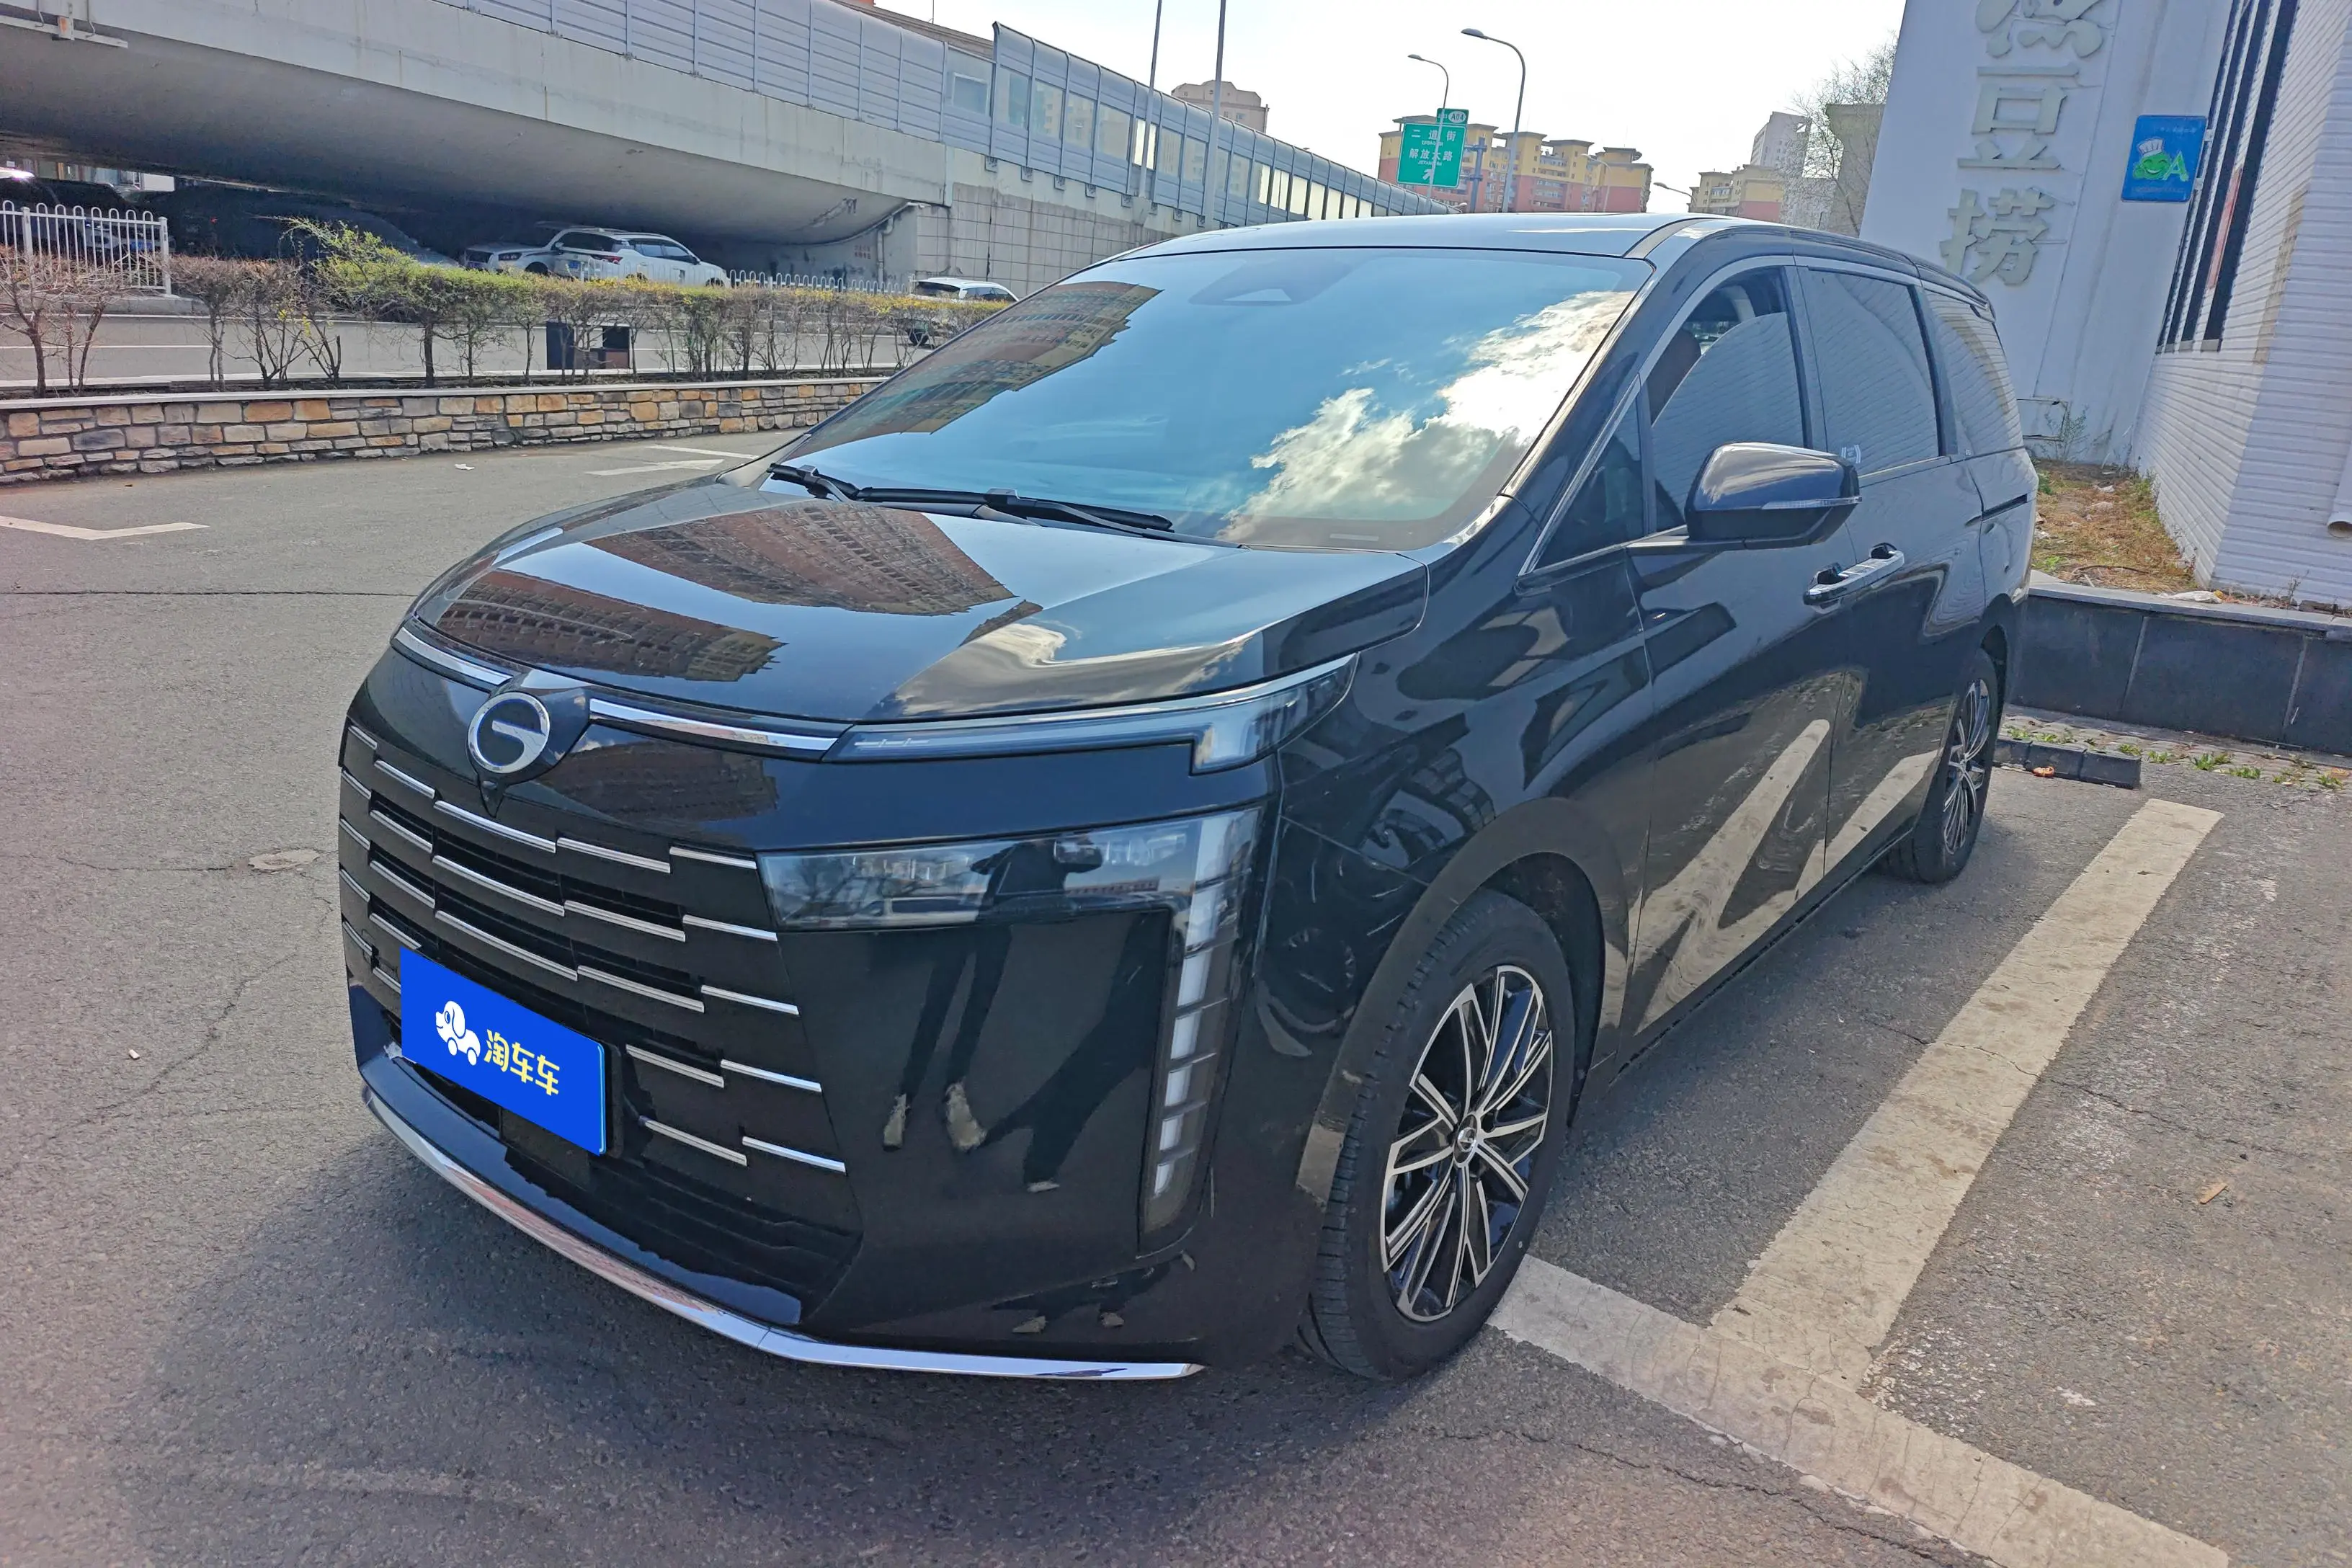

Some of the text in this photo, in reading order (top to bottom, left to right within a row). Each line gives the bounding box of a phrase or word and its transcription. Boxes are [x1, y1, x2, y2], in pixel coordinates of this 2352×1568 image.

[1450, 112, 1465, 121] A04
[1411, 129, 1456, 142] 二道街
[1409, 148, 1453, 161] 解放大路
